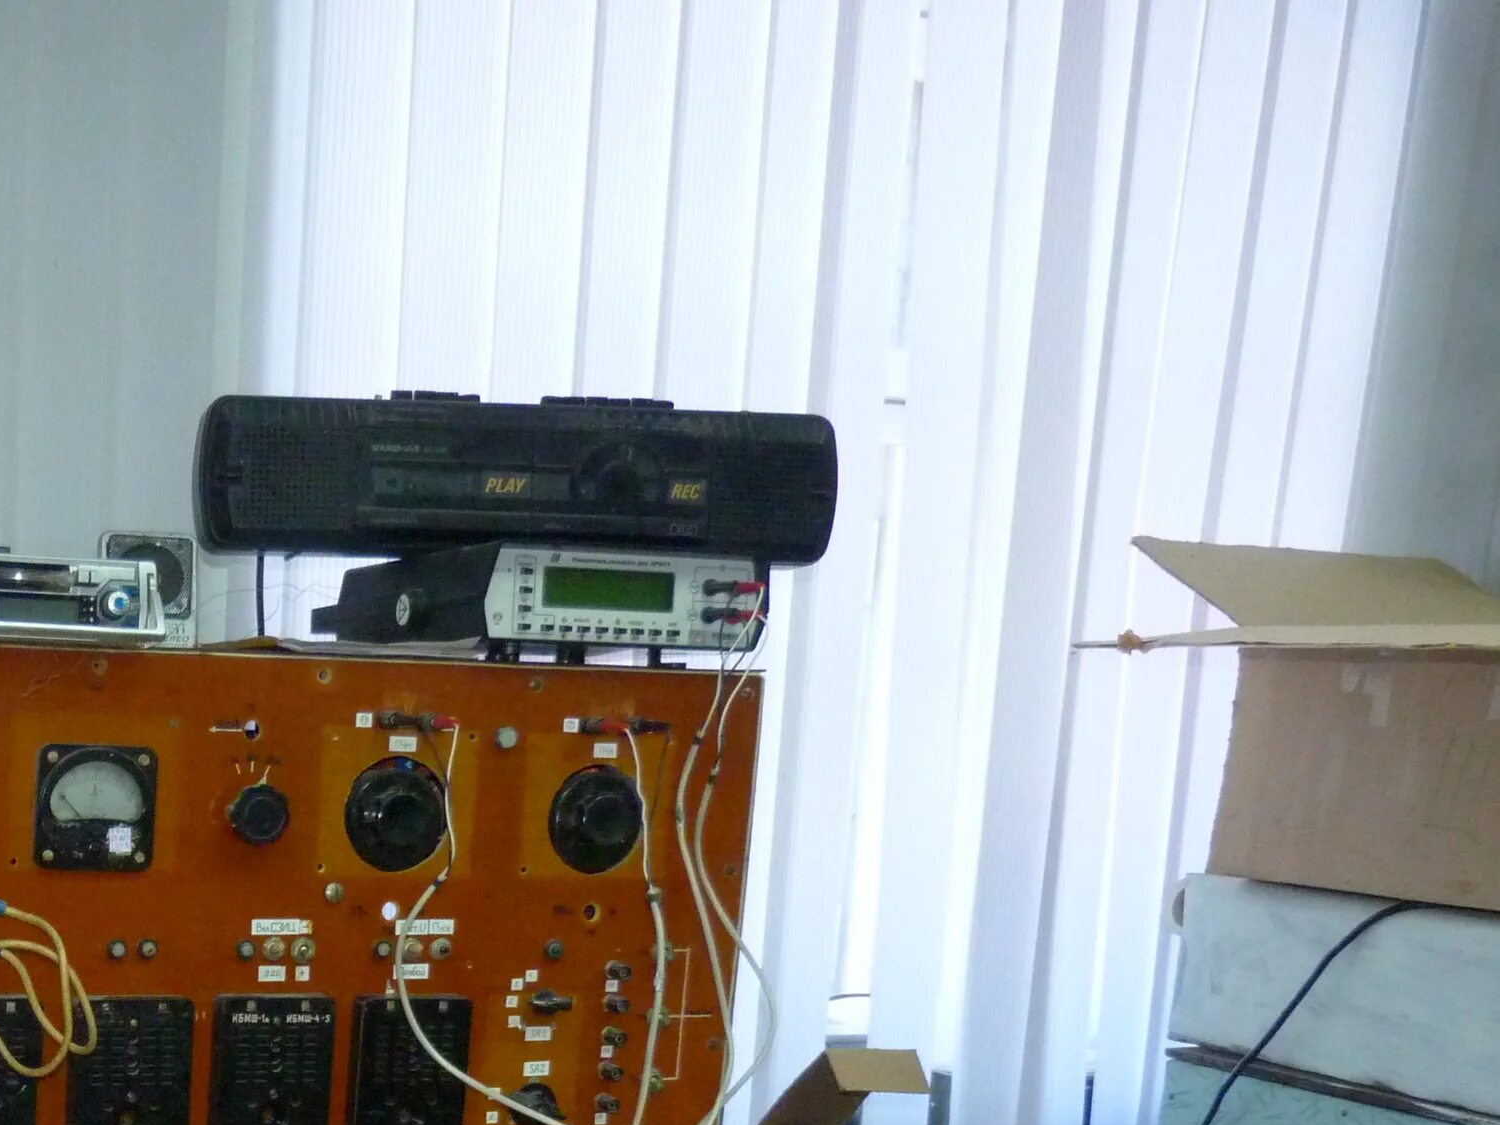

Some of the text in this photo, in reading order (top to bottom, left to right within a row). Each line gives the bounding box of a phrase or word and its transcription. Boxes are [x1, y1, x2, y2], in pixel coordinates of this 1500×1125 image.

[485, 478, 527, 493] PLAY
[670, 484, 701, 499] REC
[529, 1063, 547, 1074] SA2
